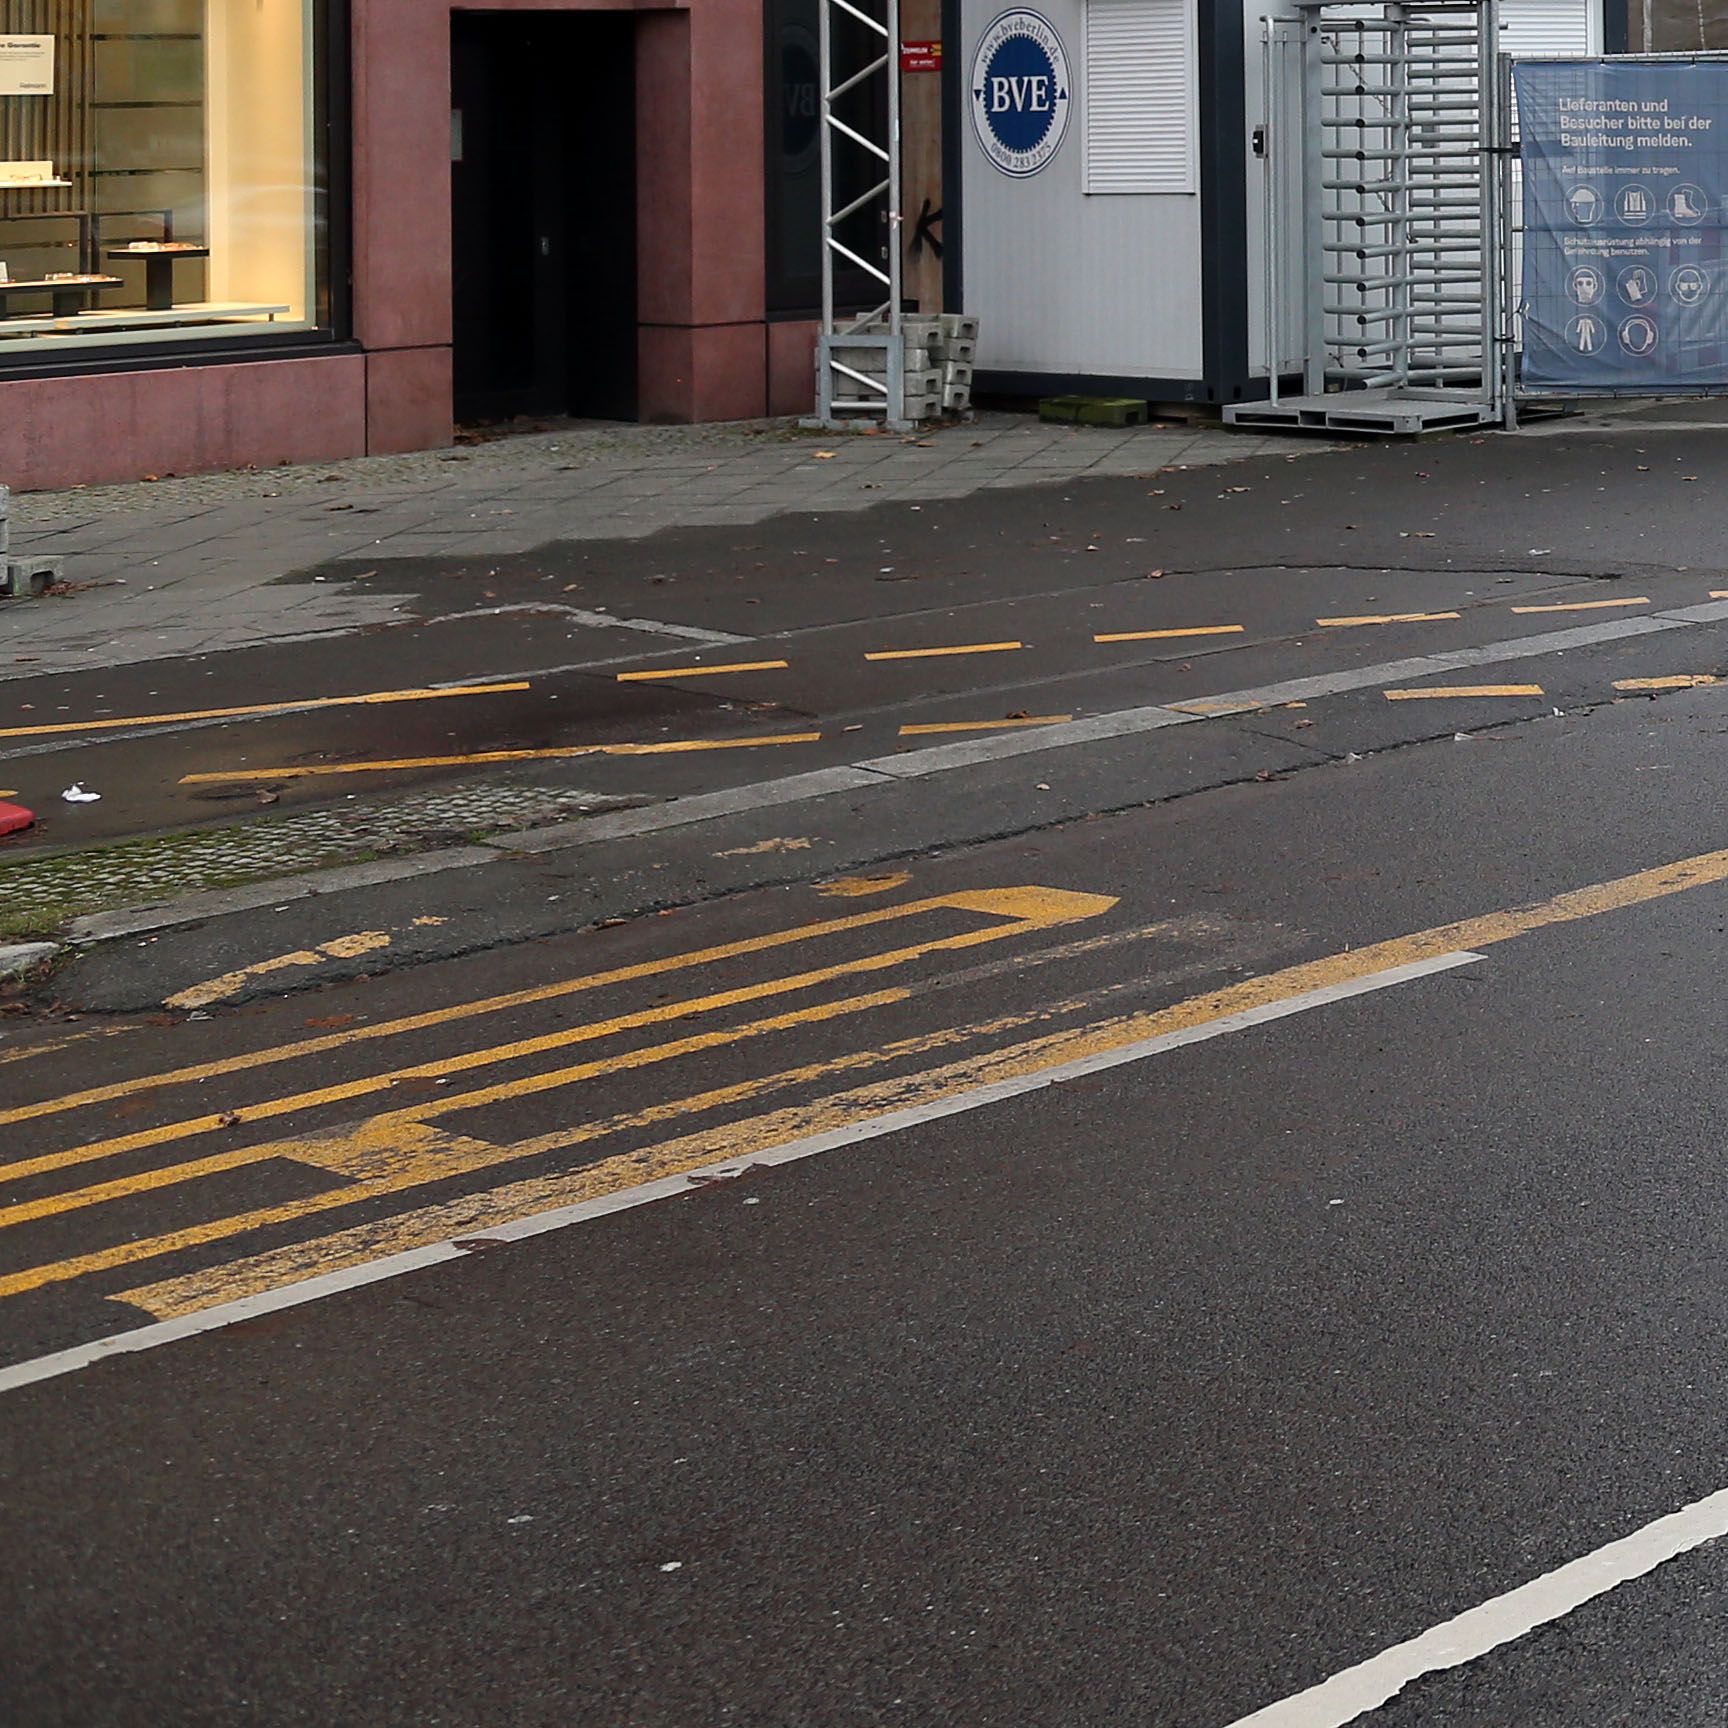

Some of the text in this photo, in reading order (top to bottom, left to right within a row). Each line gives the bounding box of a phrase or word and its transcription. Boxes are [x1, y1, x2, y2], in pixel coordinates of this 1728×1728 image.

[981, 17, 1060, 64] www.bveberlin.de
[990, 75, 1050, 113] BVE
[1559, 97, 1669, 112] Lieferanten und
[1560, 115, 1713, 130] Besucher bitte bei der
[1561, 133, 1693, 150] Bauleitung melden.
[1013, 154, 1031, 169] 283
[1614, 166, 1641, 174] immer
[1652, 166, 1681, 176] tragen.
[1689, 236, 1702, 245] der
